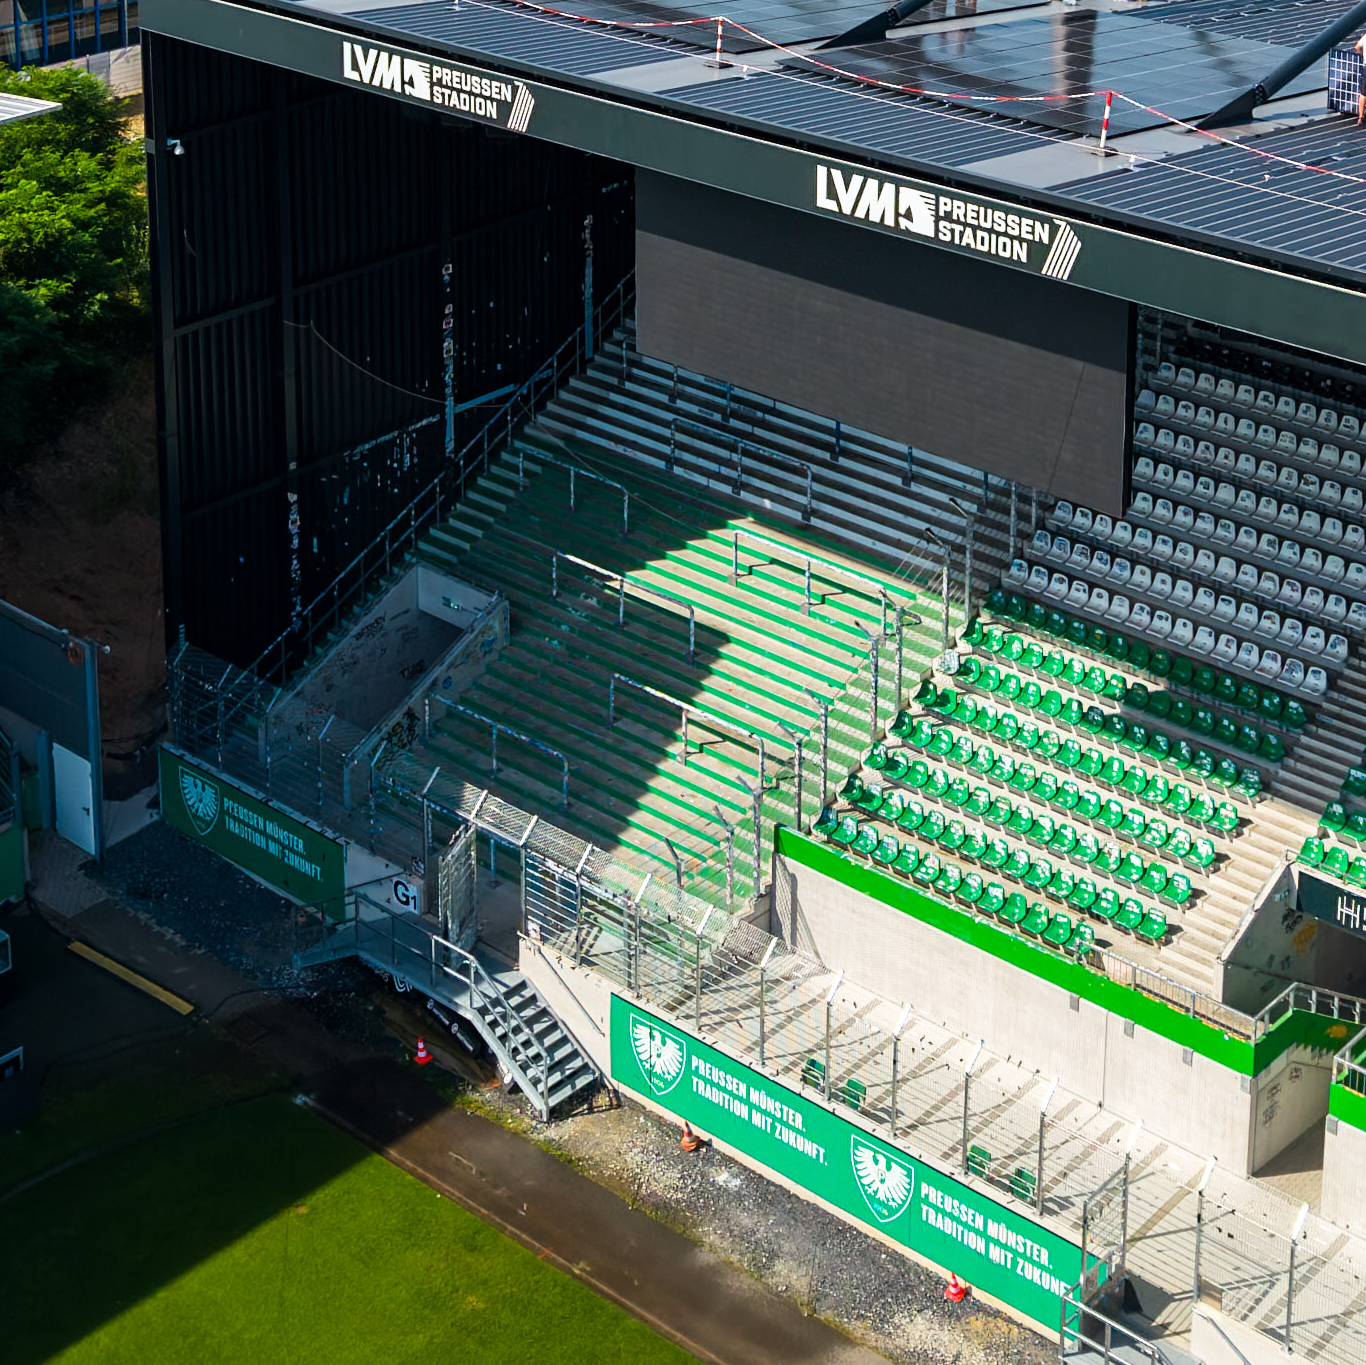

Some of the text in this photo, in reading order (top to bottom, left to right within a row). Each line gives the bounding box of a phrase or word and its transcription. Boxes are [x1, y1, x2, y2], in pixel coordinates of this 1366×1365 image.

[343, 41, 402, 92] LVM
[433, 66, 512, 105] PREUSSEN
[433, 90, 497, 120] STADION
[816, 165, 896, 227] LVM
[939, 196, 1050, 244] PREUSSEN
[939, 221, 1028, 263] STADION
[225, 815, 267, 851] TRADITION
[268, 838, 283, 860] MIT
[692, 1055, 806, 1132] PREUSSEN MÜNSTER.
[692, 1075, 828, 1166] TRADITION MIT ZUKUNFT.
[920, 1182, 1053, 1269] PREUSSEN MÜNSTER.
[920, 1203, 985, 1255] TRADITION
[989, 1242, 1013, 1269] MIT
